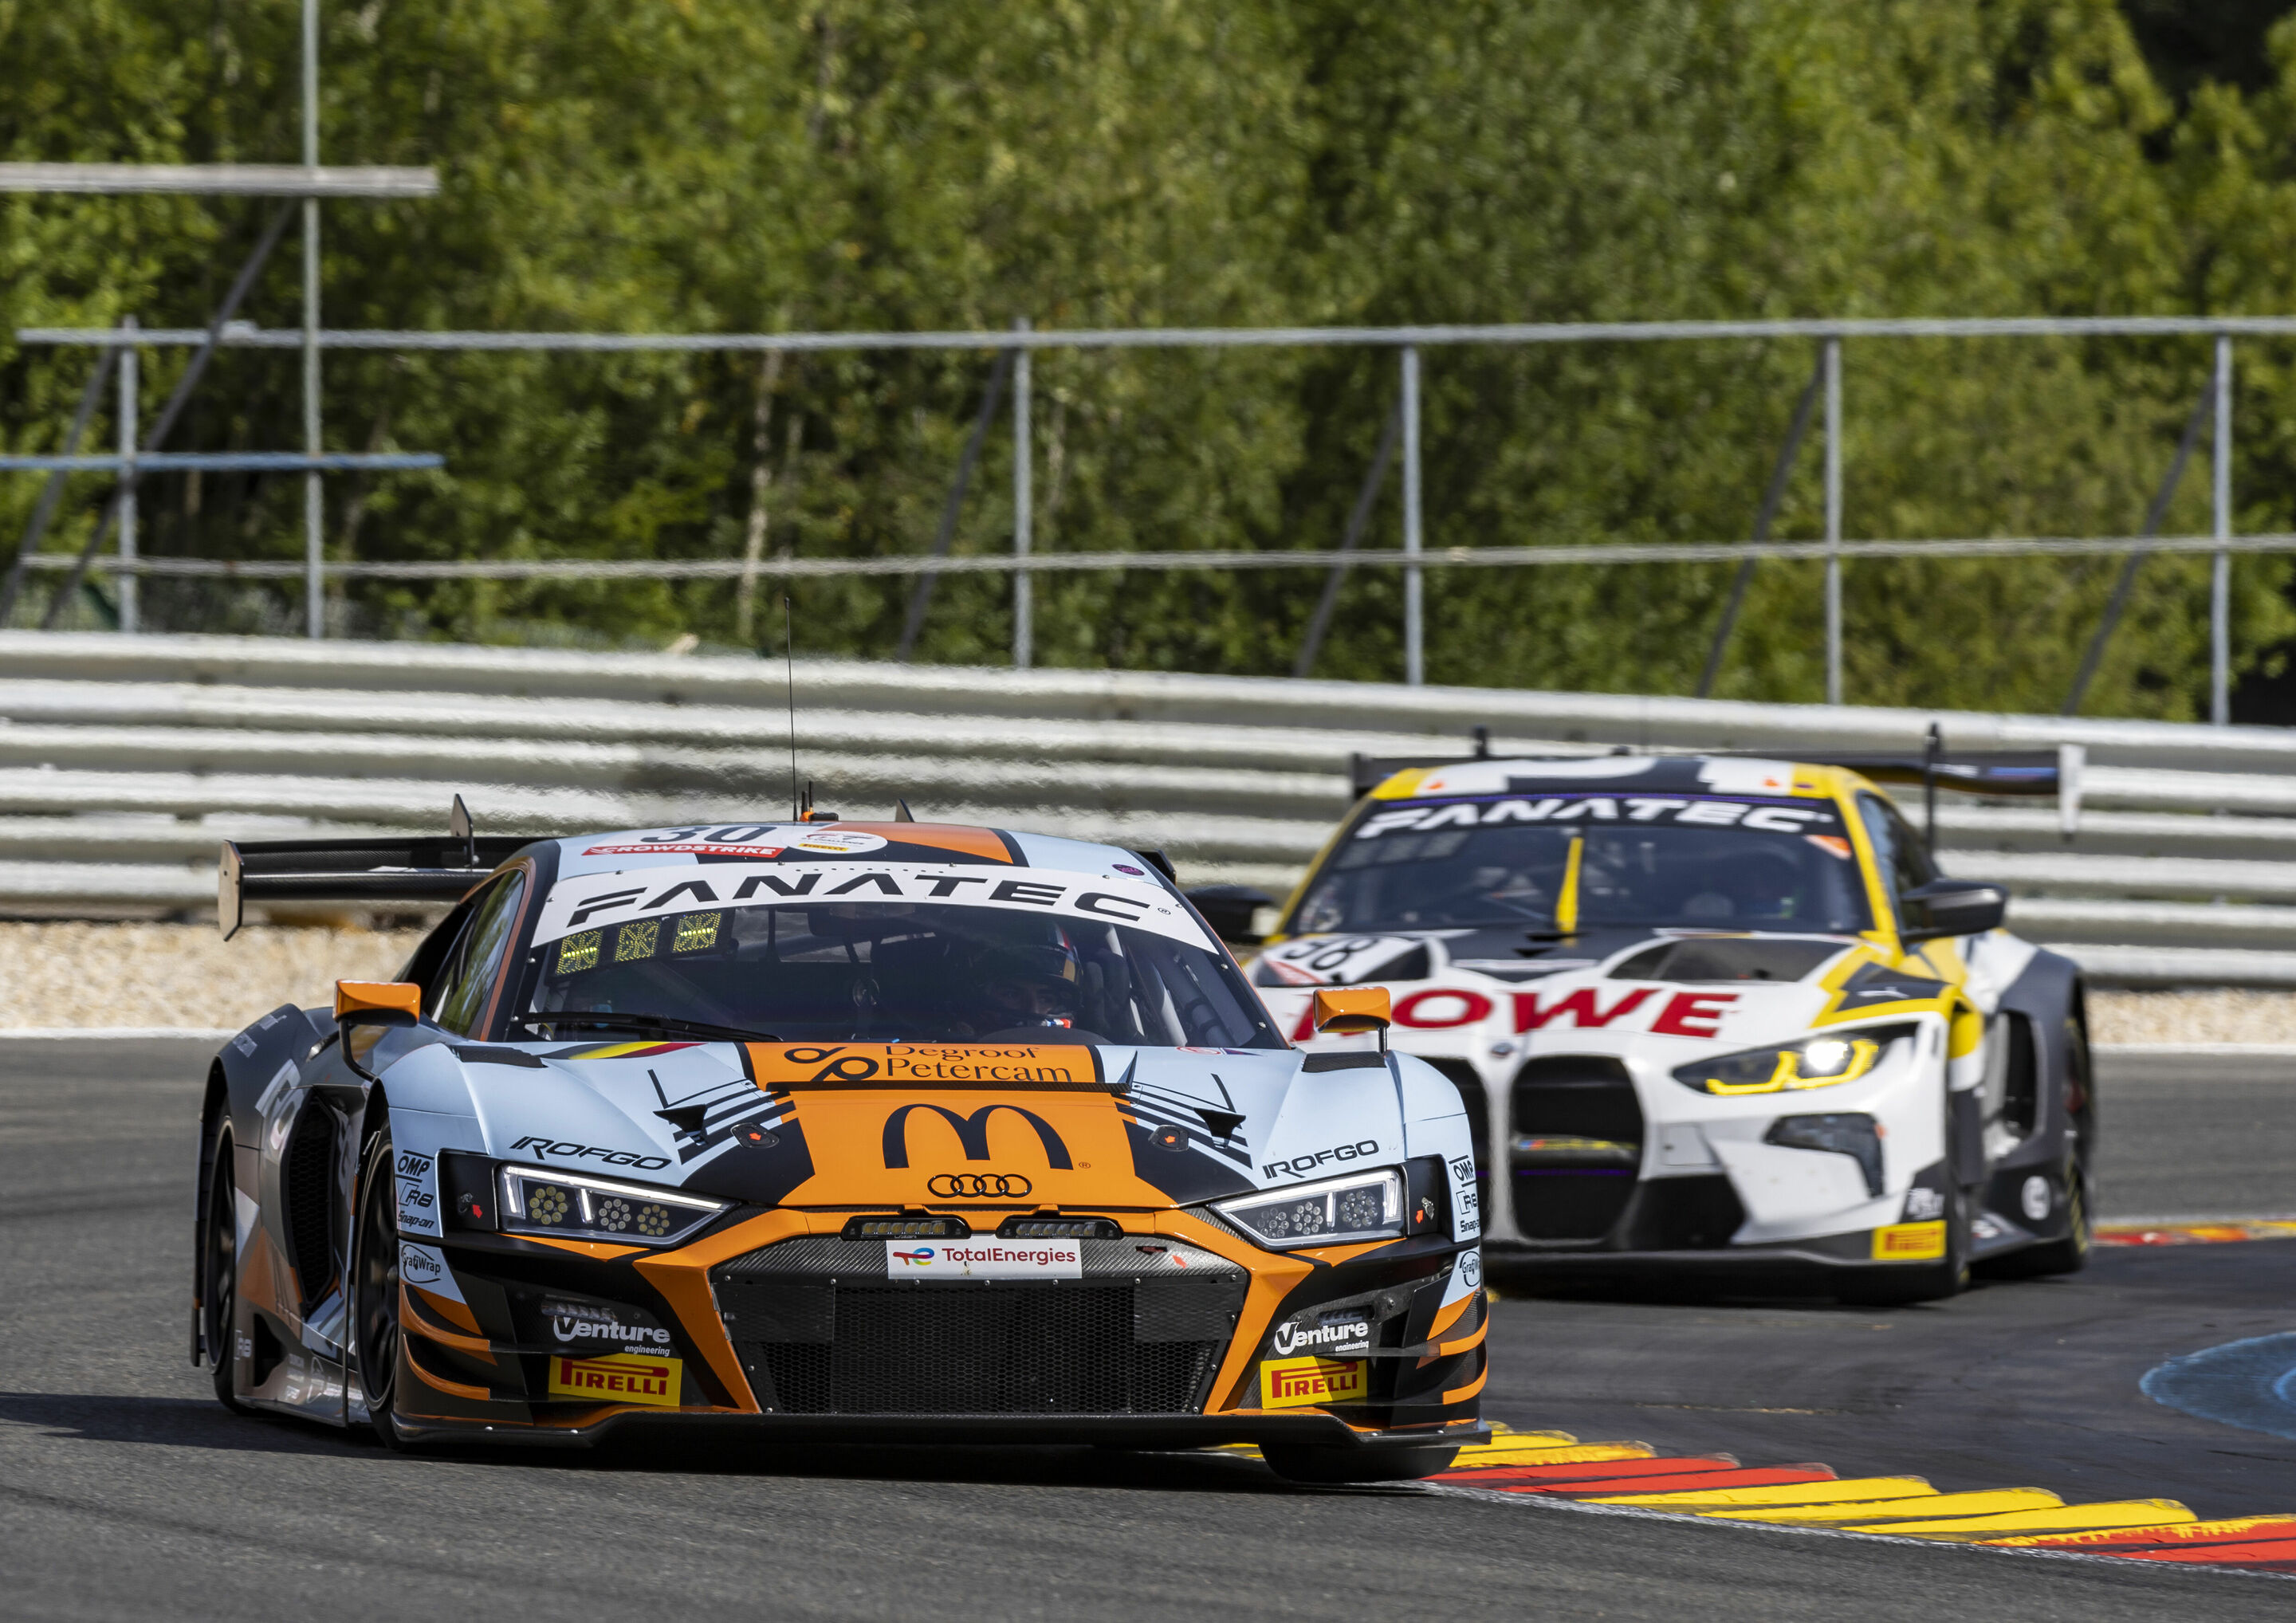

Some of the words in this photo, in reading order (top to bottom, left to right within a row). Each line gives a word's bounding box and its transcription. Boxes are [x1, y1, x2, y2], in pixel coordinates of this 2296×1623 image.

[1355, 797, 1819, 839] FANATEC
[640, 826, 777, 843] 30
[601, 844, 776, 855] CROWDSTRIKE
[566, 873, 1150, 928] FANATEC
[885, 1045, 1040, 1061] Degroof
[887, 1058, 1072, 1083] Petercam
[398, 1155, 431, 1177] OMP
[1453, 1160, 1474, 1181] OMP
[405, 1189, 434, 1208] R8
[398, 1210, 434, 1229] Snap-on
[942, 1248, 1076, 1266] TotalEnergies
[553, 1315, 670, 1343] Venture
[1274, 1321, 1369, 1355] Venture
[624, 1344, 670, 1357] engineering
[1335, 1340, 1370, 1352] engineering
[560, 1358, 670, 1395] PIRELLI
[1271, 1362, 1358, 1398] PIRELLI
